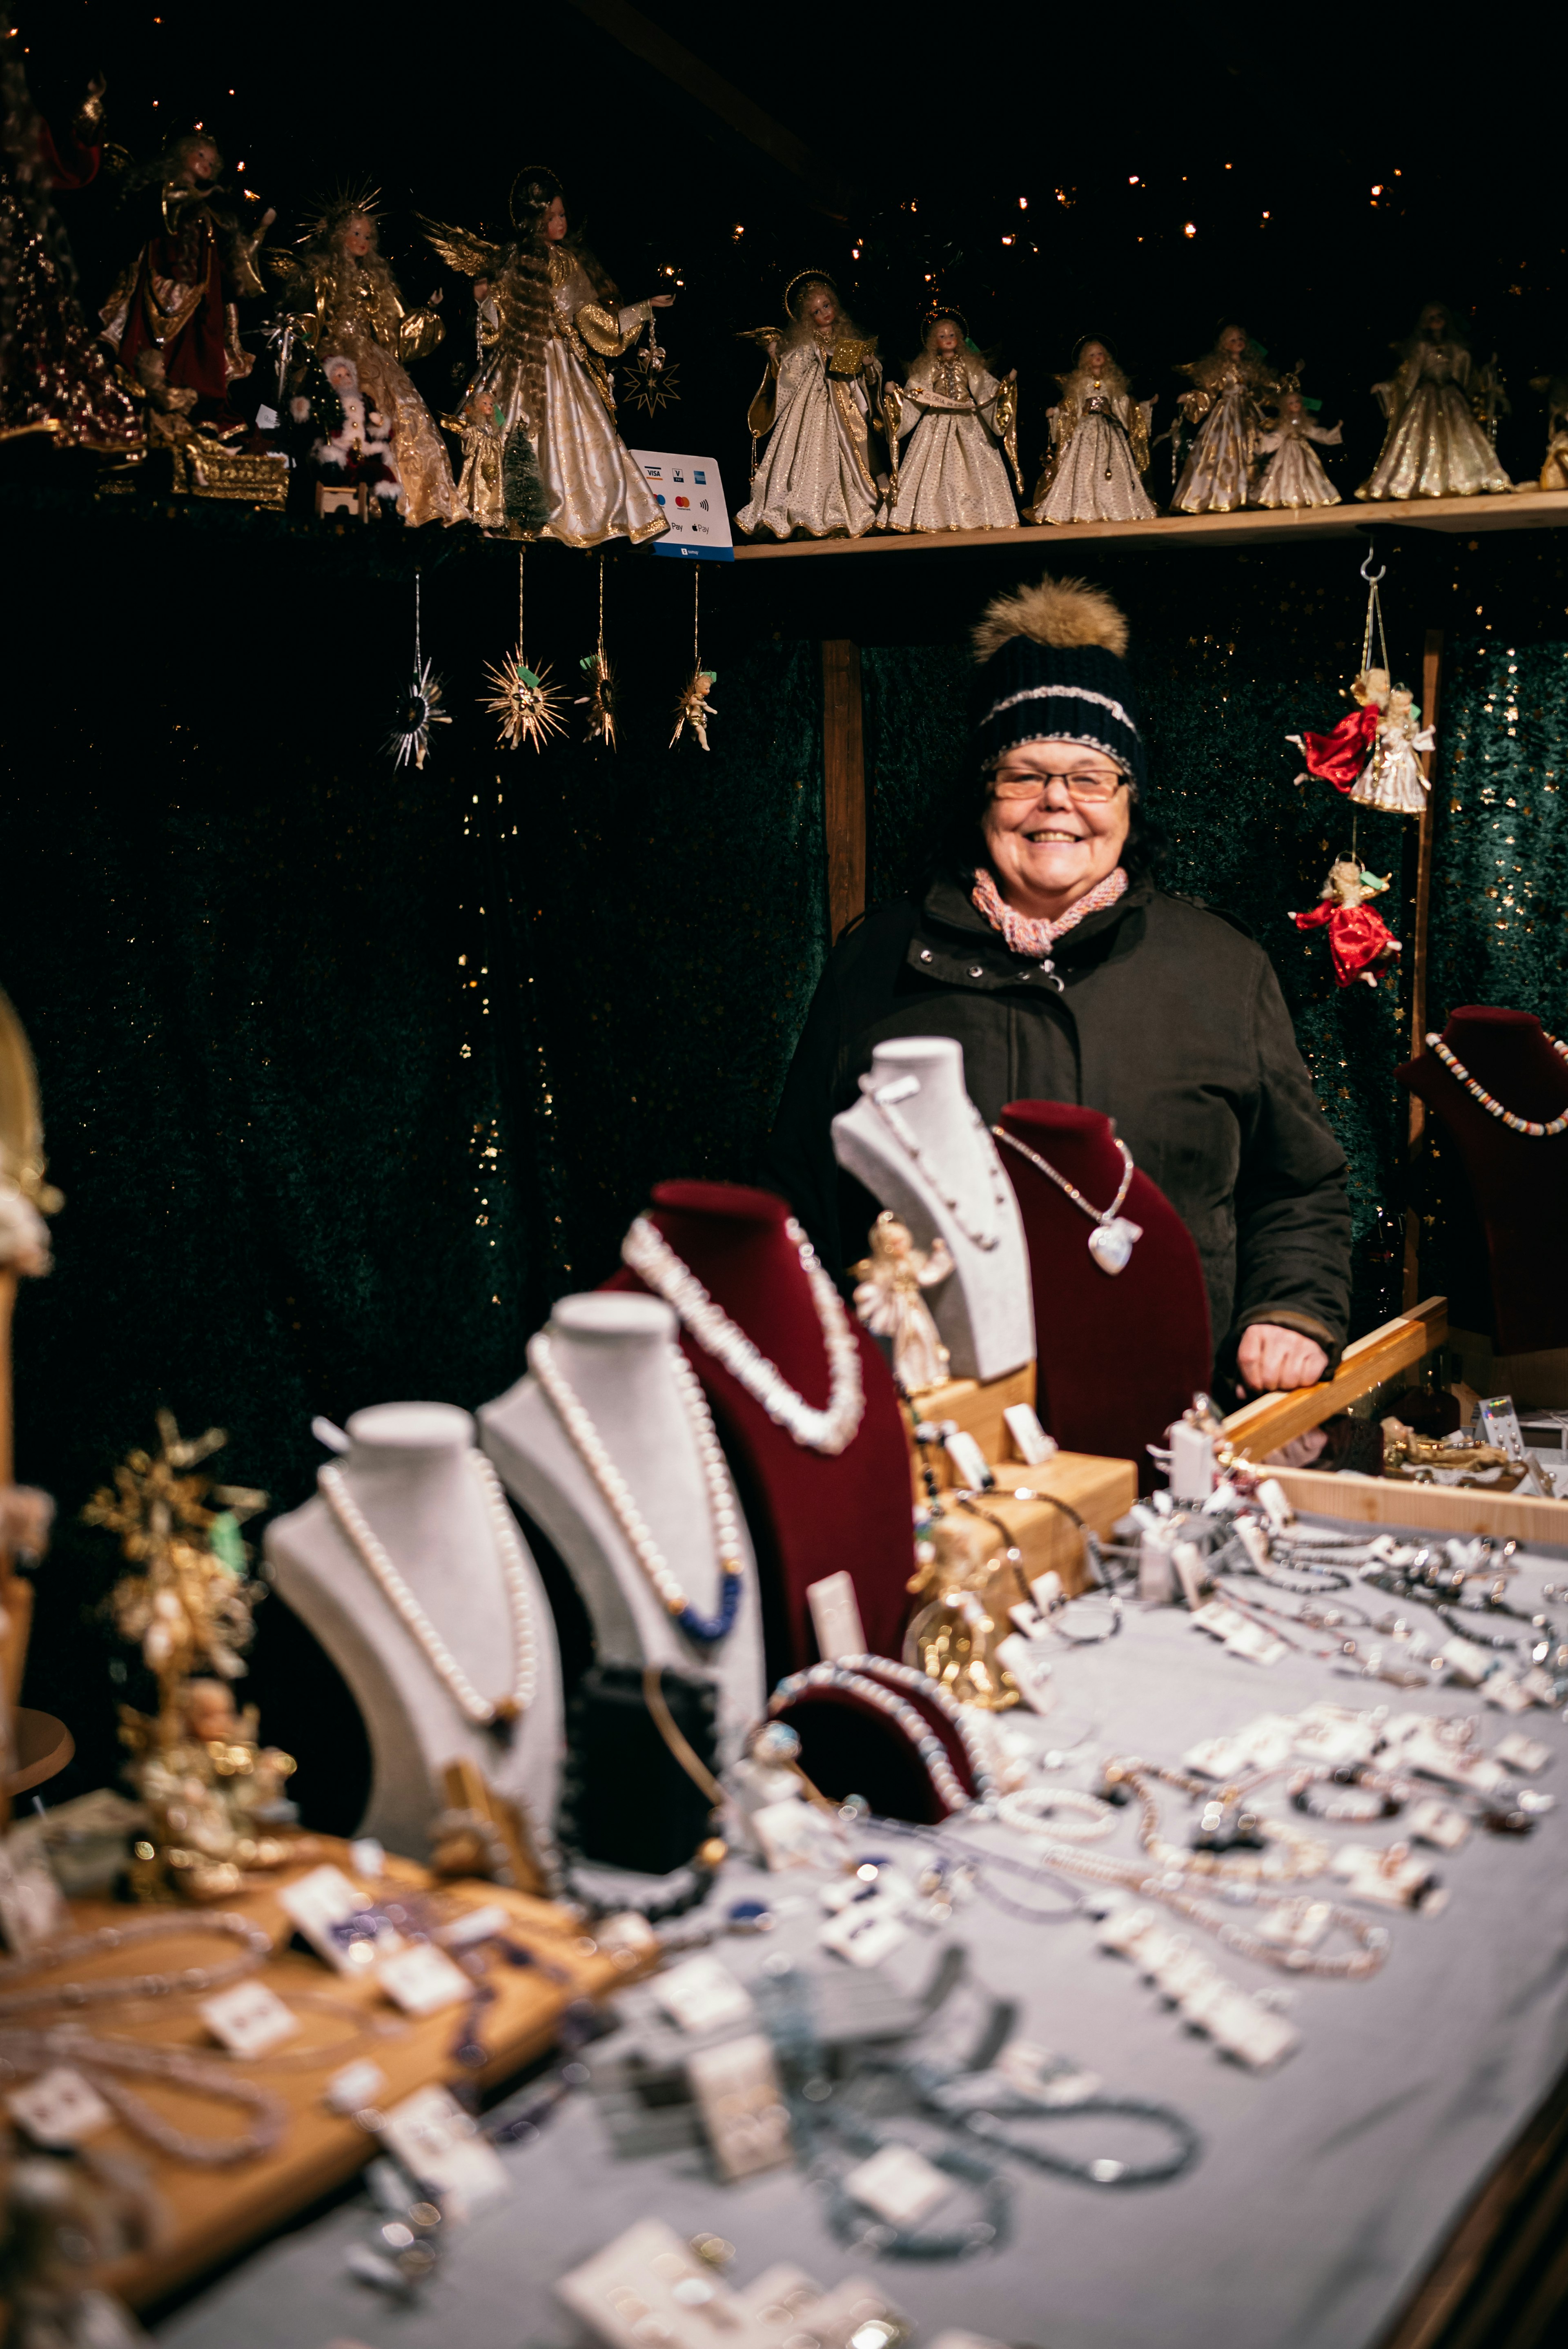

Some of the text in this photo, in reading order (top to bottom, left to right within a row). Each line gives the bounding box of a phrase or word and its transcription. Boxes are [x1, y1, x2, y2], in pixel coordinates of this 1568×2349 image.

[924, 393, 945, 405] GLORIA
[671, 523, 683, 532] Pay
[698, 524, 709, 535] Pay
